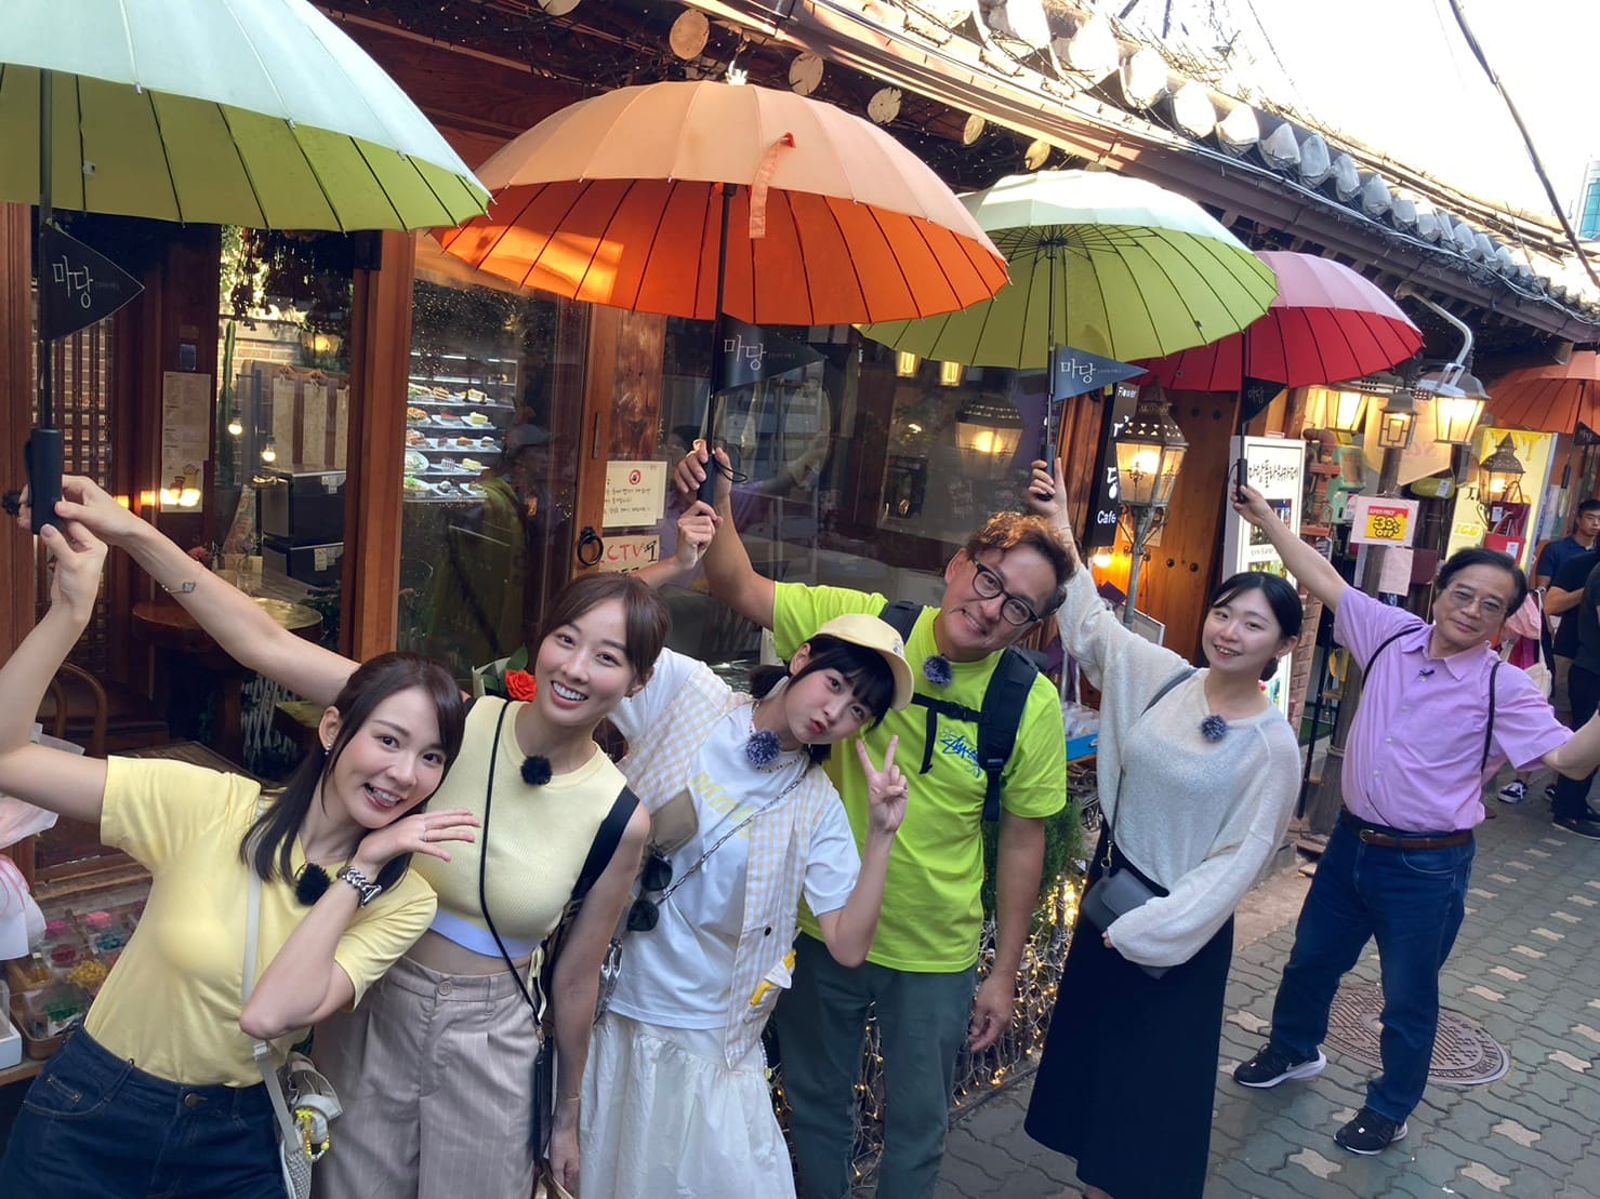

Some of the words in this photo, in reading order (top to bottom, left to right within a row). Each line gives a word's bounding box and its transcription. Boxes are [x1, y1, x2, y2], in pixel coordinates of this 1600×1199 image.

[52, 254, 94, 309] 마당
[724, 334, 767, 371] 마당
[1060, 358, 1097, 384] 마당
